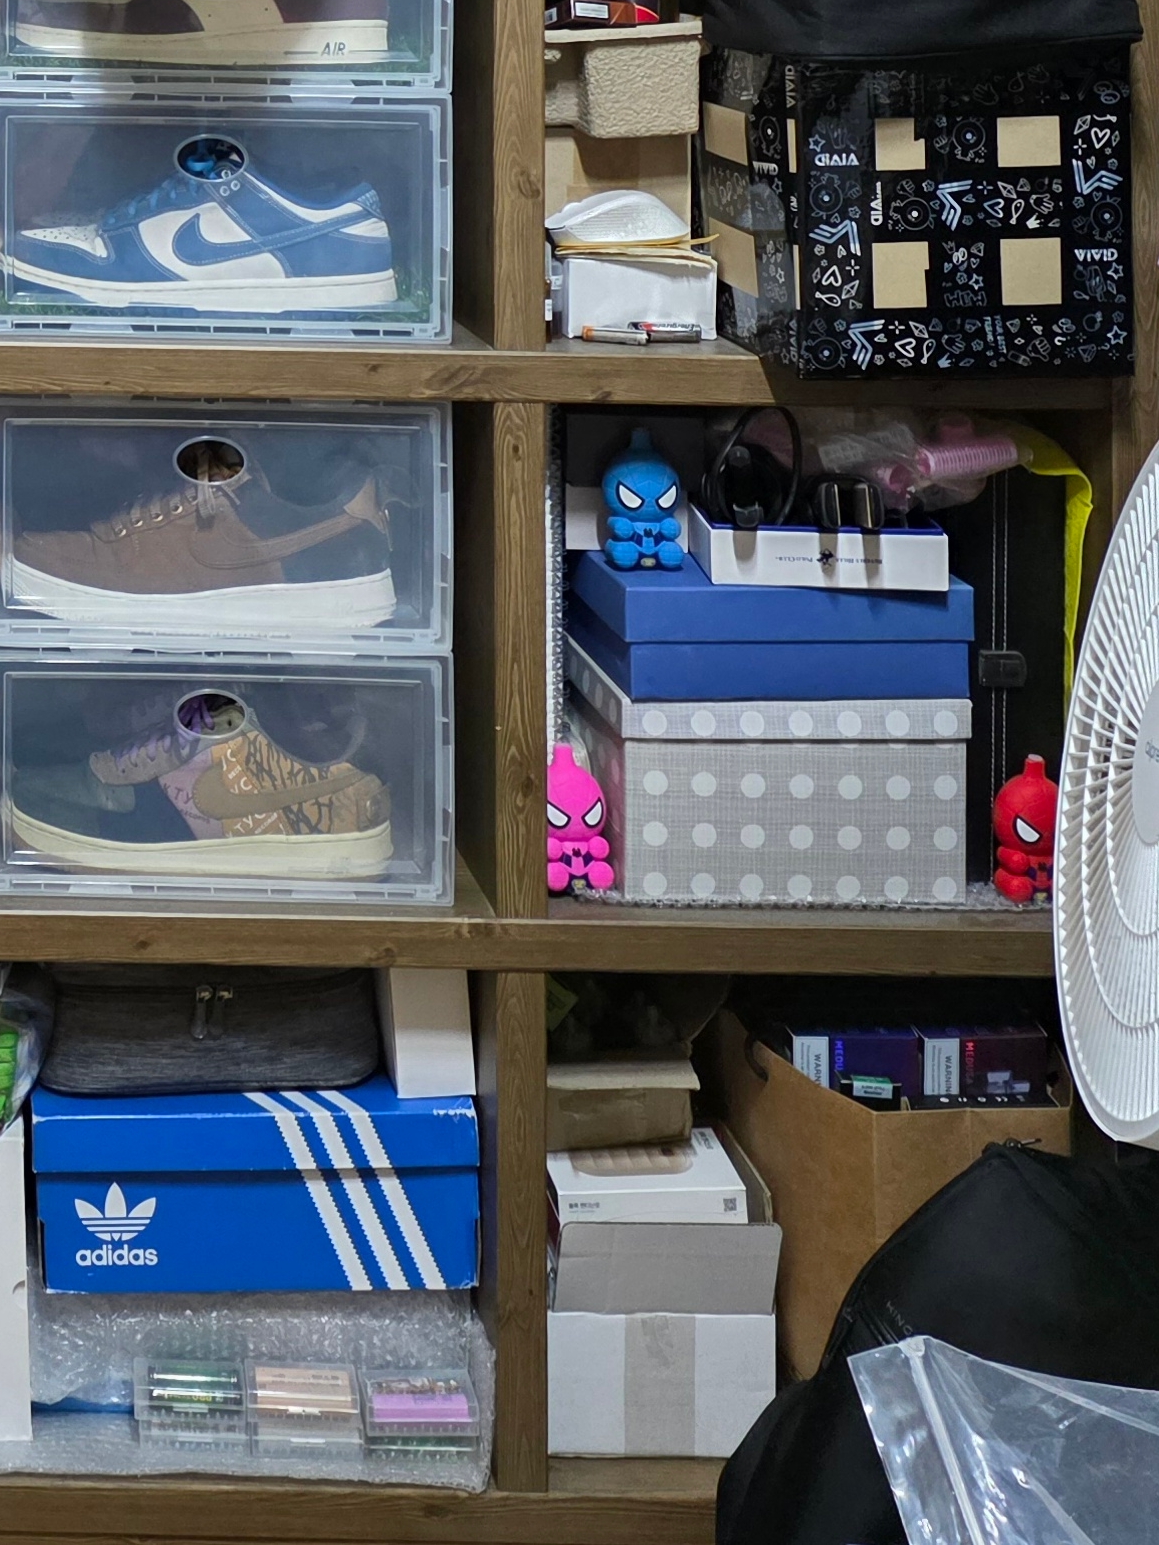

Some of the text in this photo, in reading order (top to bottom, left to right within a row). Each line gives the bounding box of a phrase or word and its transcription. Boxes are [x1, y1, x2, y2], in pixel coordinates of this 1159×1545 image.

[321, 42, 346, 56] AIR
[785, 65, 796, 108] VIVID
[814, 153, 860, 166] VIVID
[752, 160, 779, 176] VIVID
[1074, 248, 1118, 262] VIVID
[965, 1041, 975, 1085] MEDUSA
[75, 1243, 158, 1267] adidas
